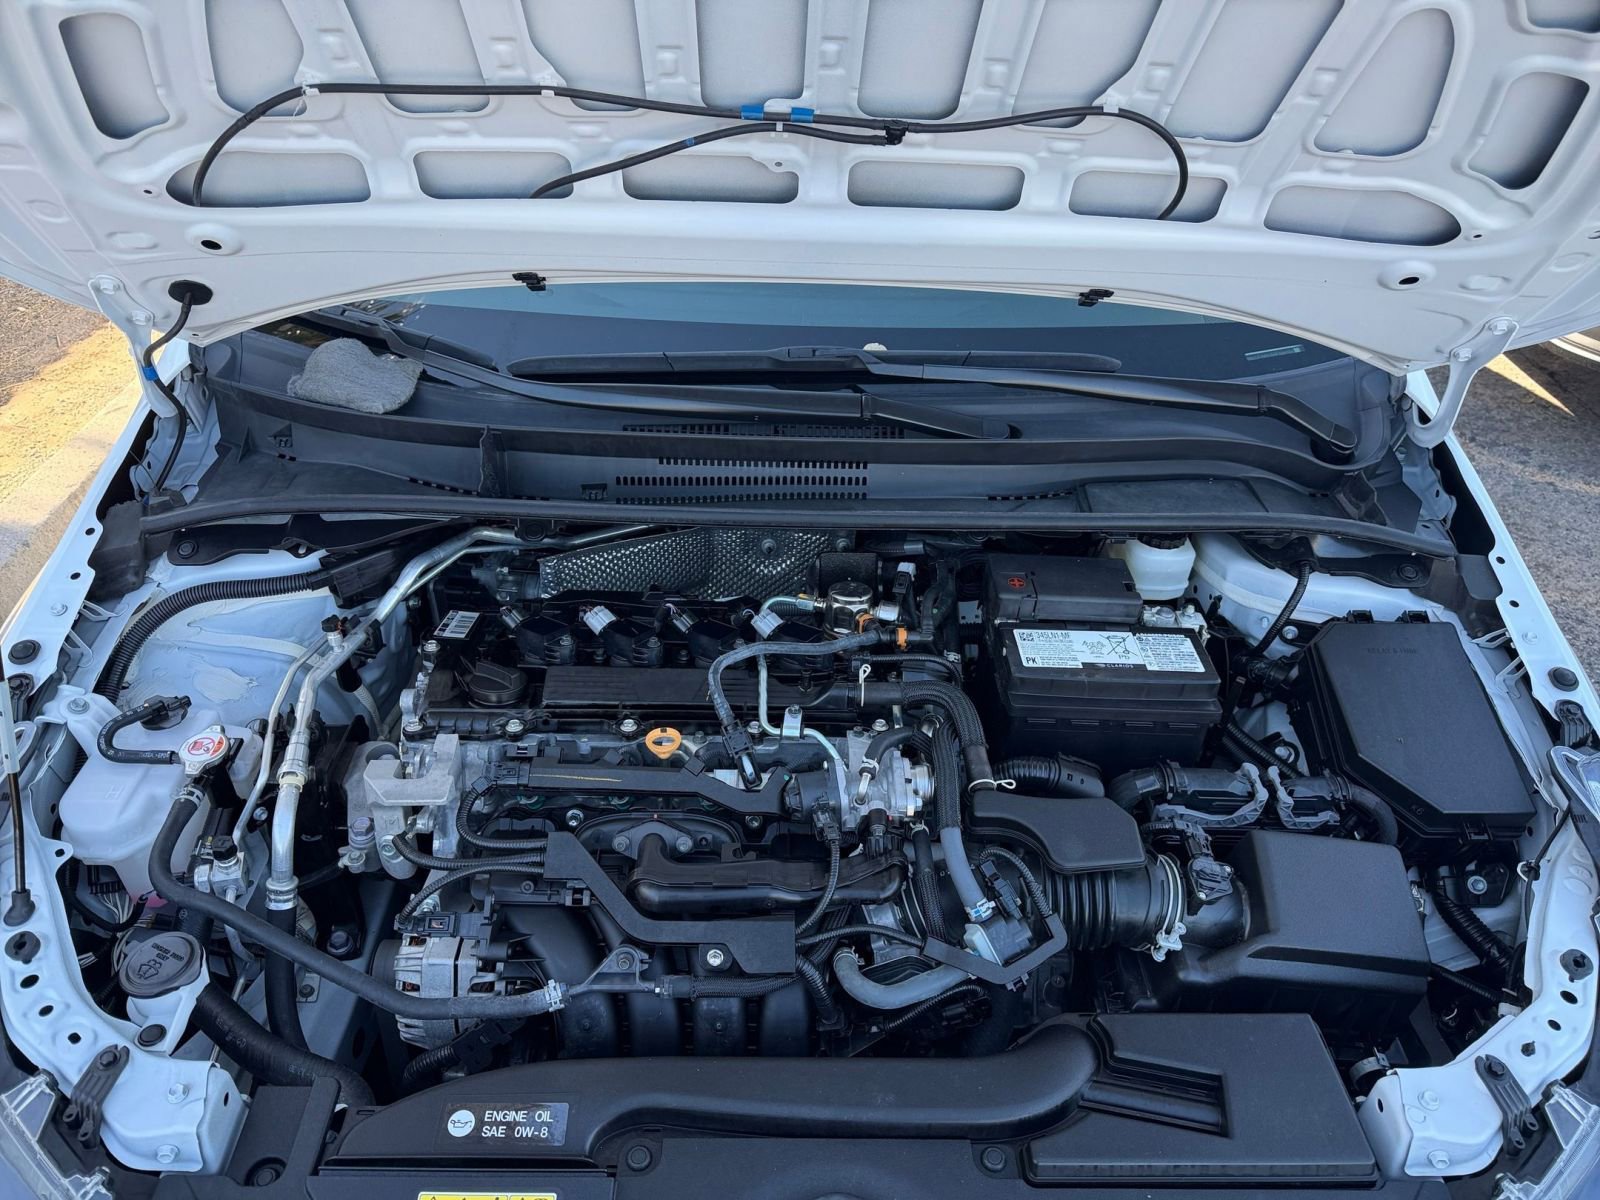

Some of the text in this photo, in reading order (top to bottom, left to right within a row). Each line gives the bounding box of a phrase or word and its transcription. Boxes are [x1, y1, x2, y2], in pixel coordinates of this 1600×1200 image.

[484, 1110, 554, 1122] ENGINE OIL
[481, 1126, 549, 1138] SAE 0W-8
